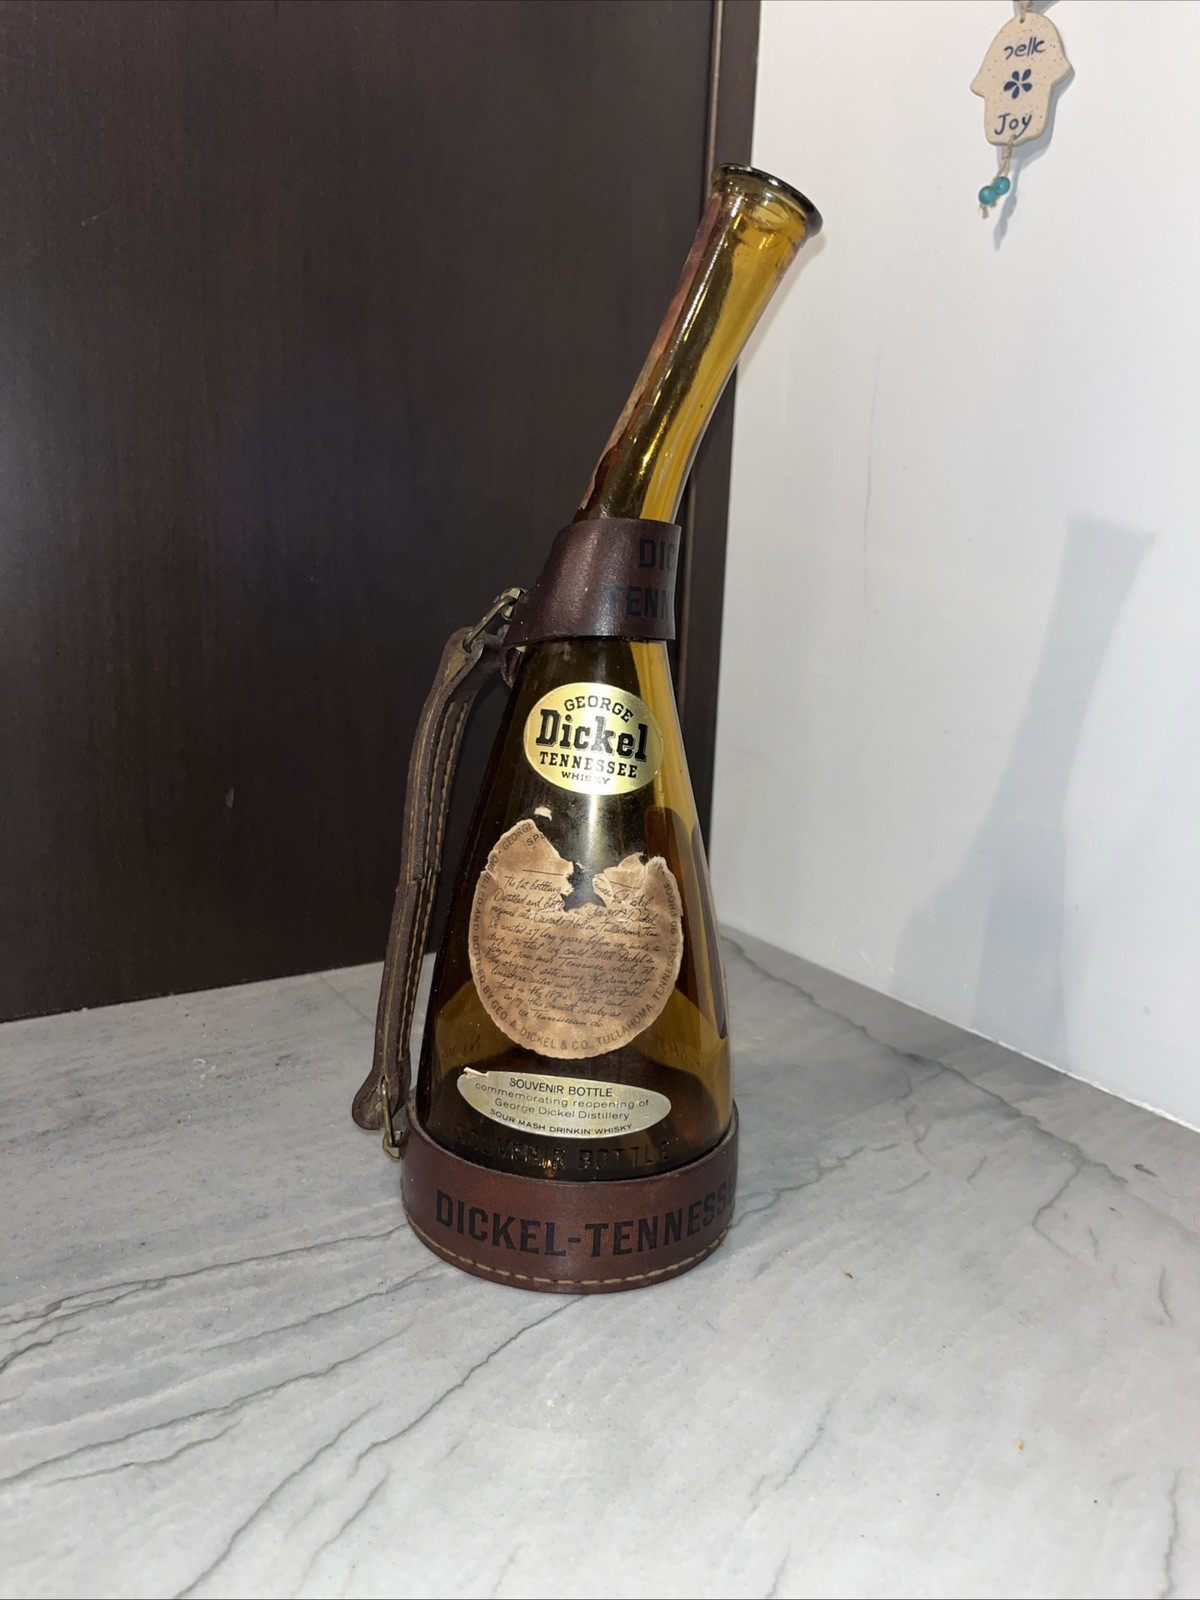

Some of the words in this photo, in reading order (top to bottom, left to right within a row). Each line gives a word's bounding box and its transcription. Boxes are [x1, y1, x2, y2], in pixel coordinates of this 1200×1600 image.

[994, 112, 1033, 140] Joy
[563, 695, 634, 723] GEORGE
[535, 708, 649, 762] Dickel
[539, 751, 638, 779] TENNESSEE
[663, 883, 678, 918] PROOF
[472, 907, 482, 931] AND
[670, 921, 678, 934] 90
[472, 935, 487, 984] BOTTLED
[483, 985, 495, 999] BY
[519, 1026, 556, 1049] DICKEL
[596, 1003, 654, 1046] TULLAHOMA,
[560, 1040, 568, 1050] &
[475, 1082, 568, 1109] commemorating
[572, 1099, 635, 1110] reopening
[638, 1098, 649, 1107] of
[509, 1077, 565, 1095] SOUVENIR
[568, 1085, 613, 1098] BOTTLE
[490, 1108, 516, 1124] SOUR
[518, 1119, 546, 1131] MASH
[549, 1126, 593, 1135] DRINKIN'
[595, 1123, 633, 1135] WHISKY
[494, 1098, 535, 1114] George
[538, 1106, 575, 1118] Dickel
[578, 1109, 630, 1120] Distillery
